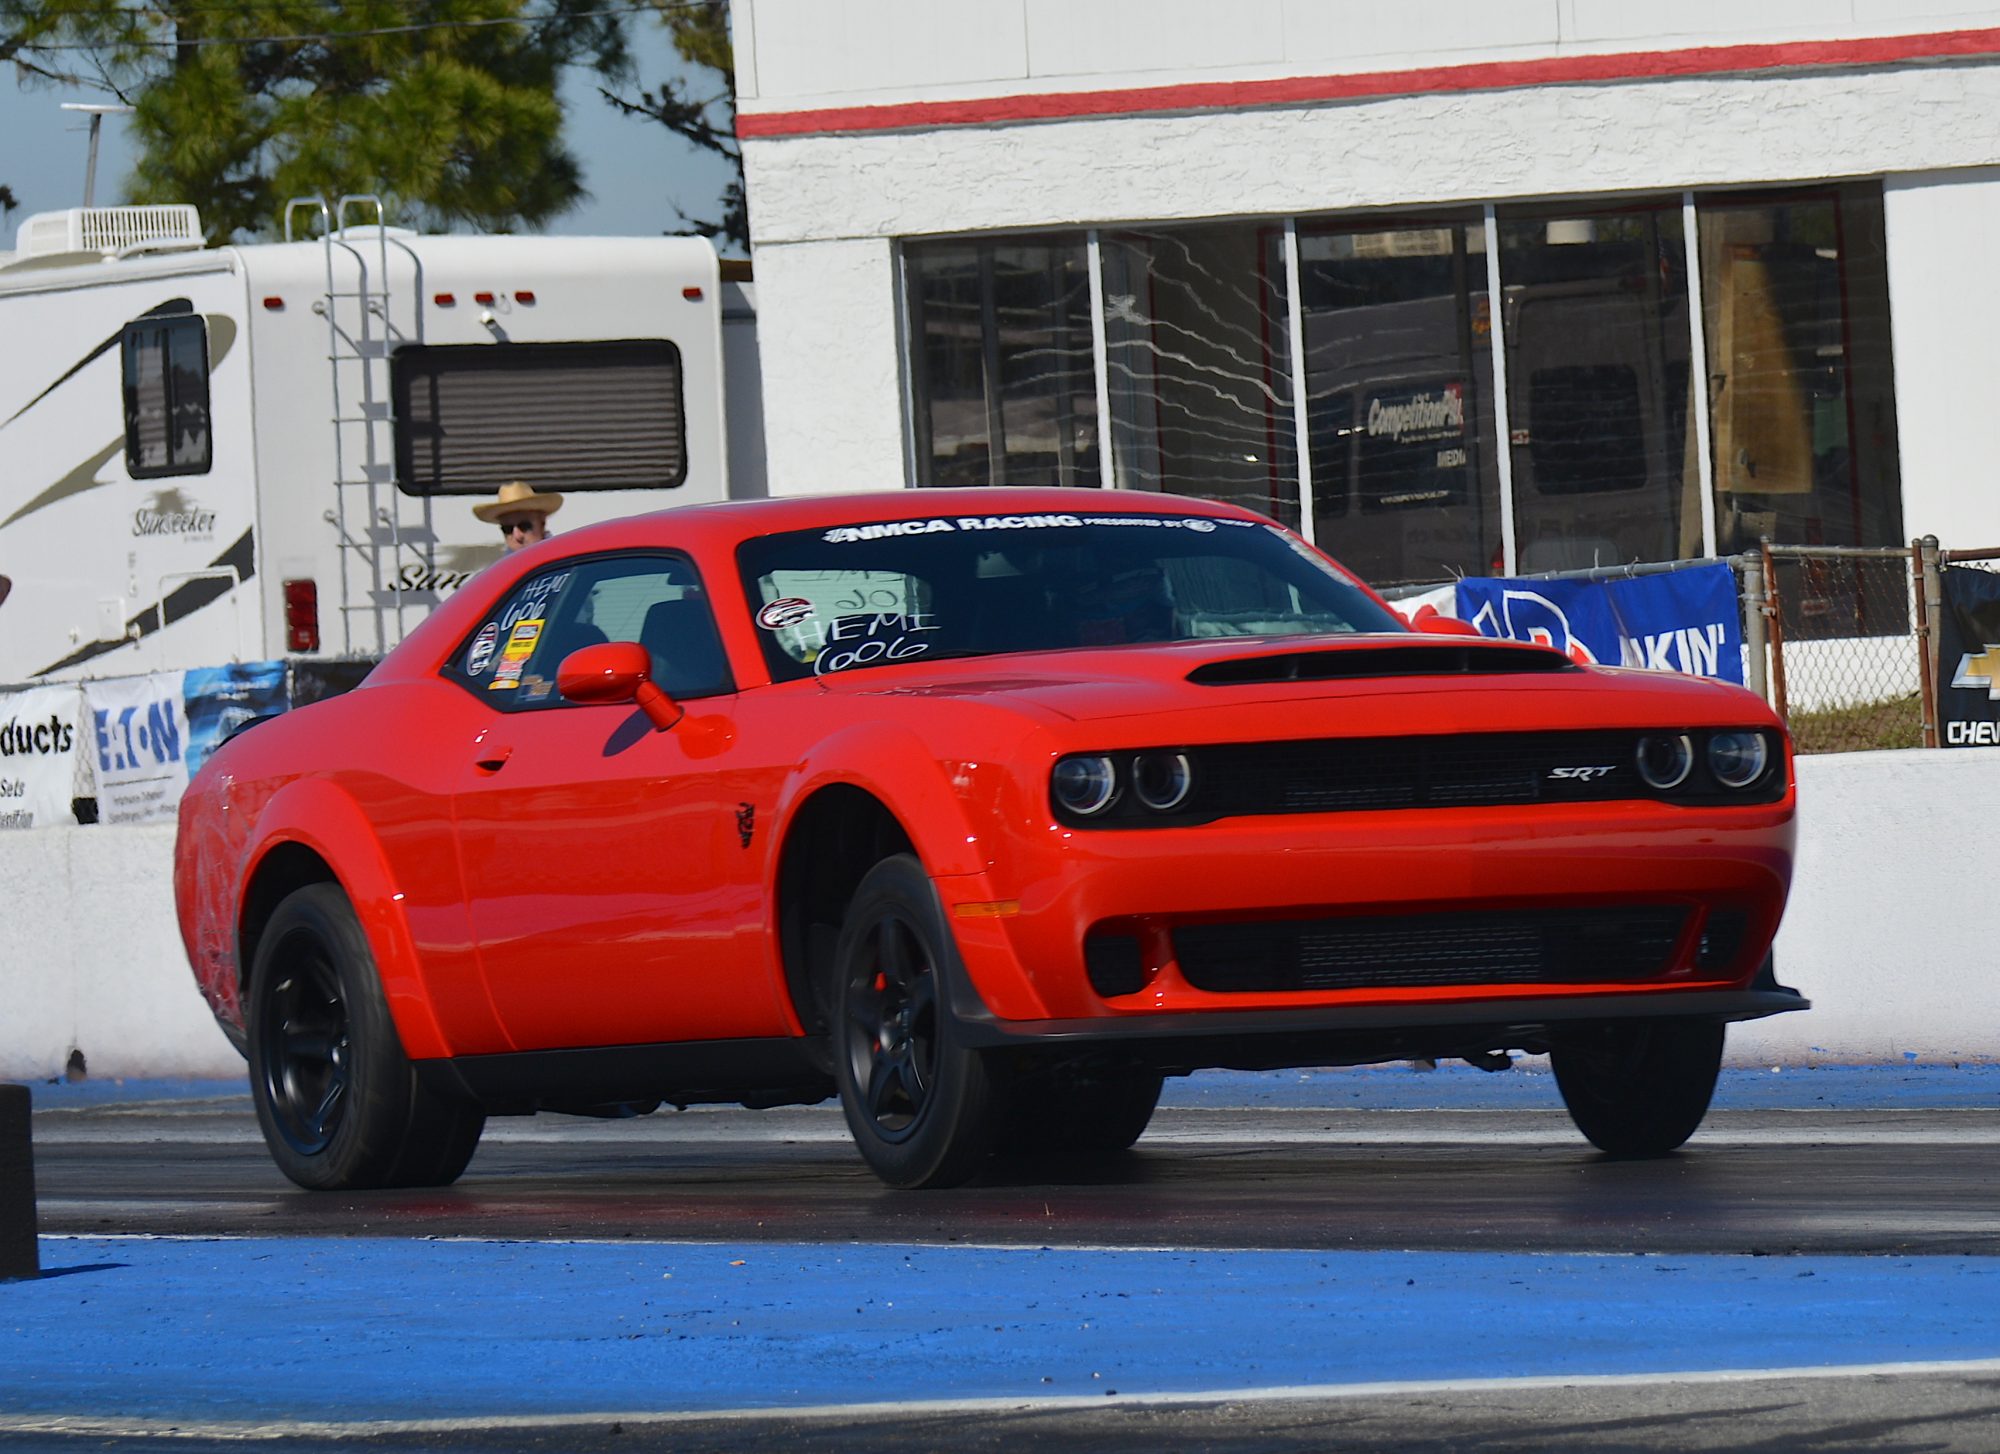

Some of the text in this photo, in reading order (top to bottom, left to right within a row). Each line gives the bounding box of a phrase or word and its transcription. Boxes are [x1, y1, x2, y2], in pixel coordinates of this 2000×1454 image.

[131, 506, 216, 537] Sunseeker
[845, 519, 956, 542] NMCA
[956, 514, 1082, 531] RACING
[521, 573, 571, 600] HEMI
[501, 594, 548, 631] 606
[793, 613, 942, 651] HEMI
[813, 636, 929, 677] 606
[0, 714, 73, 757] ducts
[1546, 765, 1617, 782] SRT
